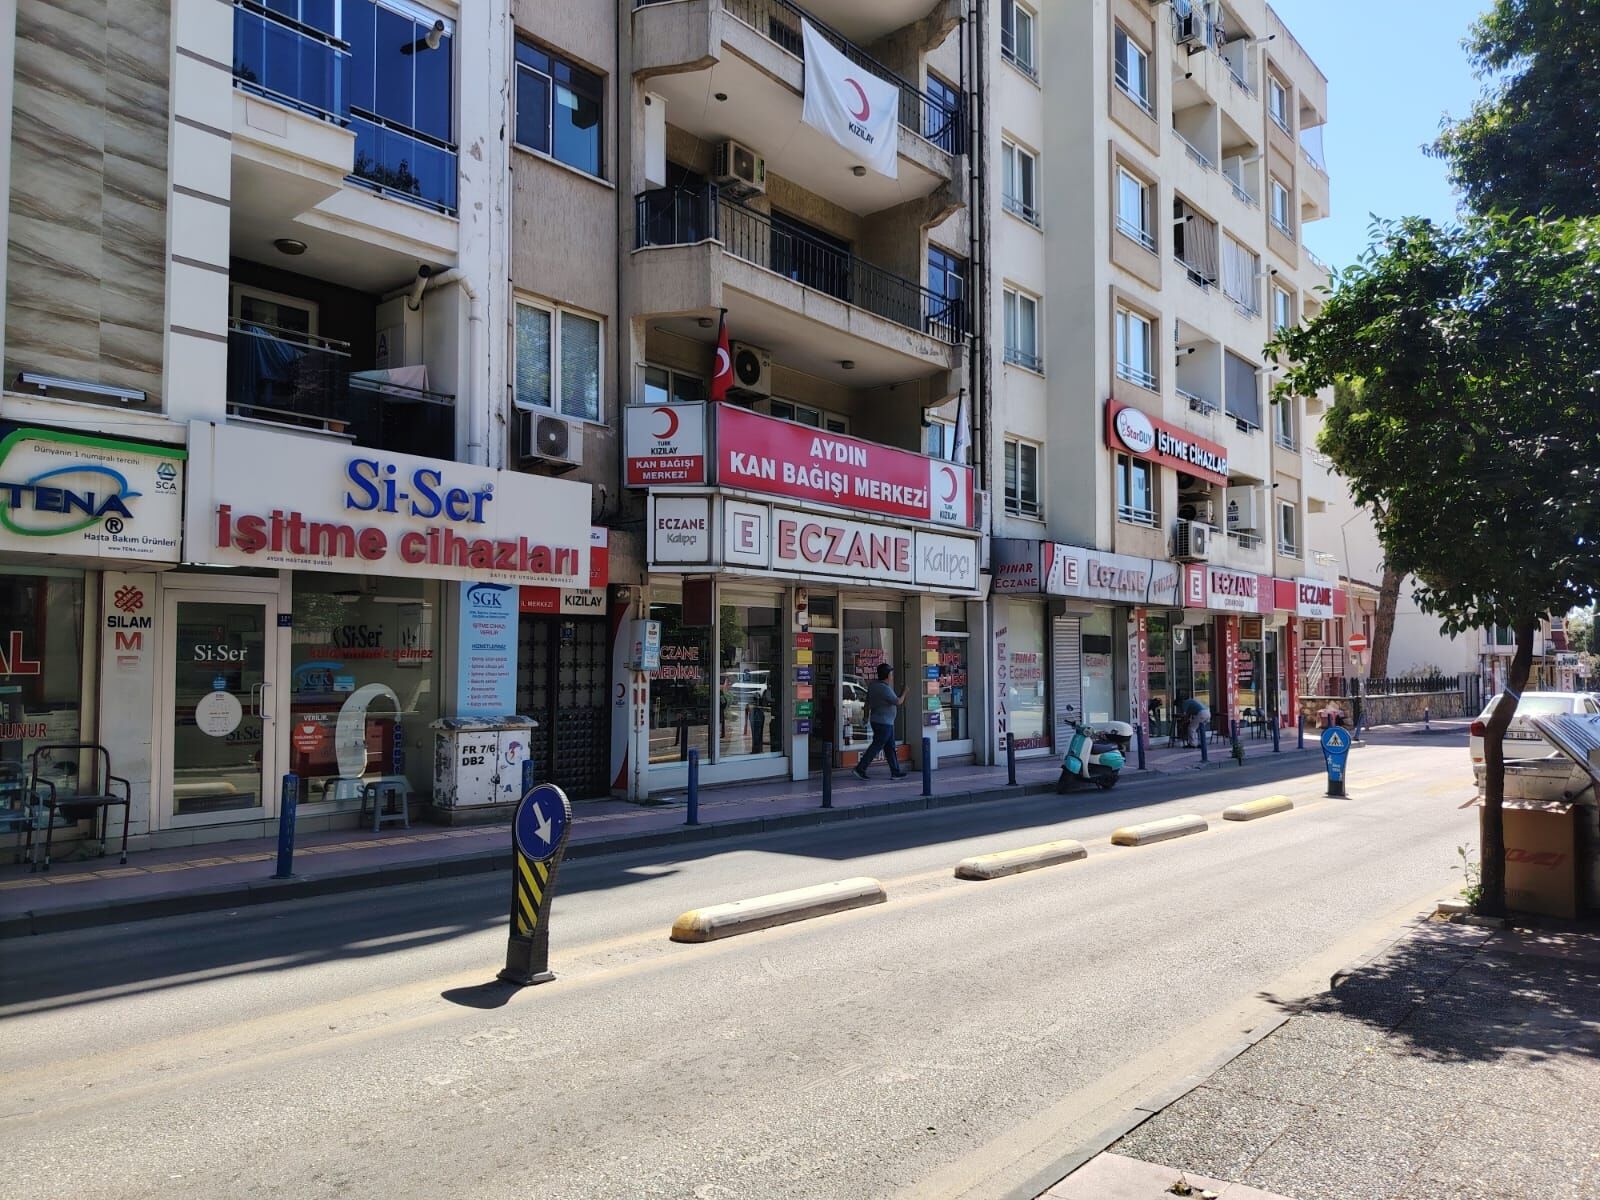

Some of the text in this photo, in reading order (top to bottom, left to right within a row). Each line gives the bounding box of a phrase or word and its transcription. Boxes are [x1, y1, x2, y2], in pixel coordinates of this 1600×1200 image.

[848, 121, 875, 145] KIZILAY
[651, 447, 679, 455] KIZILAY
[809, 437, 868, 468] AYDIN
[1157, 428, 1229, 476] İŞİTME CİHAZLARI
[636, 458, 694, 470] KAN BAĞIŞI
[642, 470, 688, 480] MERKEZİ
[730, 450, 928, 509] KAN BAĞIŞI MERKEZİ
[155, 481, 177, 491] SCA
[346, 458, 493, 524] Si-Ser
[0, 482, 134, 519] TENA
[658, 518, 705, 530] ECZANE
[84, 532, 177, 547] Hasta Bakım Ürünleri
[215, 503, 579, 576] işitme cihazları
[666, 533, 697, 547] Kalıpçı
[741, 520, 754, 548] E
[778, 518, 911, 573] ECZANE
[923, 544, 970, 580] Kalıpçı
[1000, 562, 1033, 575] PINAR
[1068, 562, 1077, 580] E
[995, 578, 1038, 588] ECZANE
[1087, 558, 1147, 593] ECZANE
[1211, 571, 1257, 598] ECZANE
[1193, 581, 1200, 598] E
[1299, 583, 1332, 606] ECZANE
[472, 592, 502, 606] SGK
[564, 594, 603, 608] KIZILAY
[107, 615, 152, 629] SILAM
[194, 644, 248, 662] Si-Ser
[660, 645, 700, 661] CZANE
[1139, 617, 1147, 735] ECZANE
[997, 643, 1006, 751] ECZANE
[462, 744, 496, 755] FR 7/6
[462, 756, 485, 767] DB2
